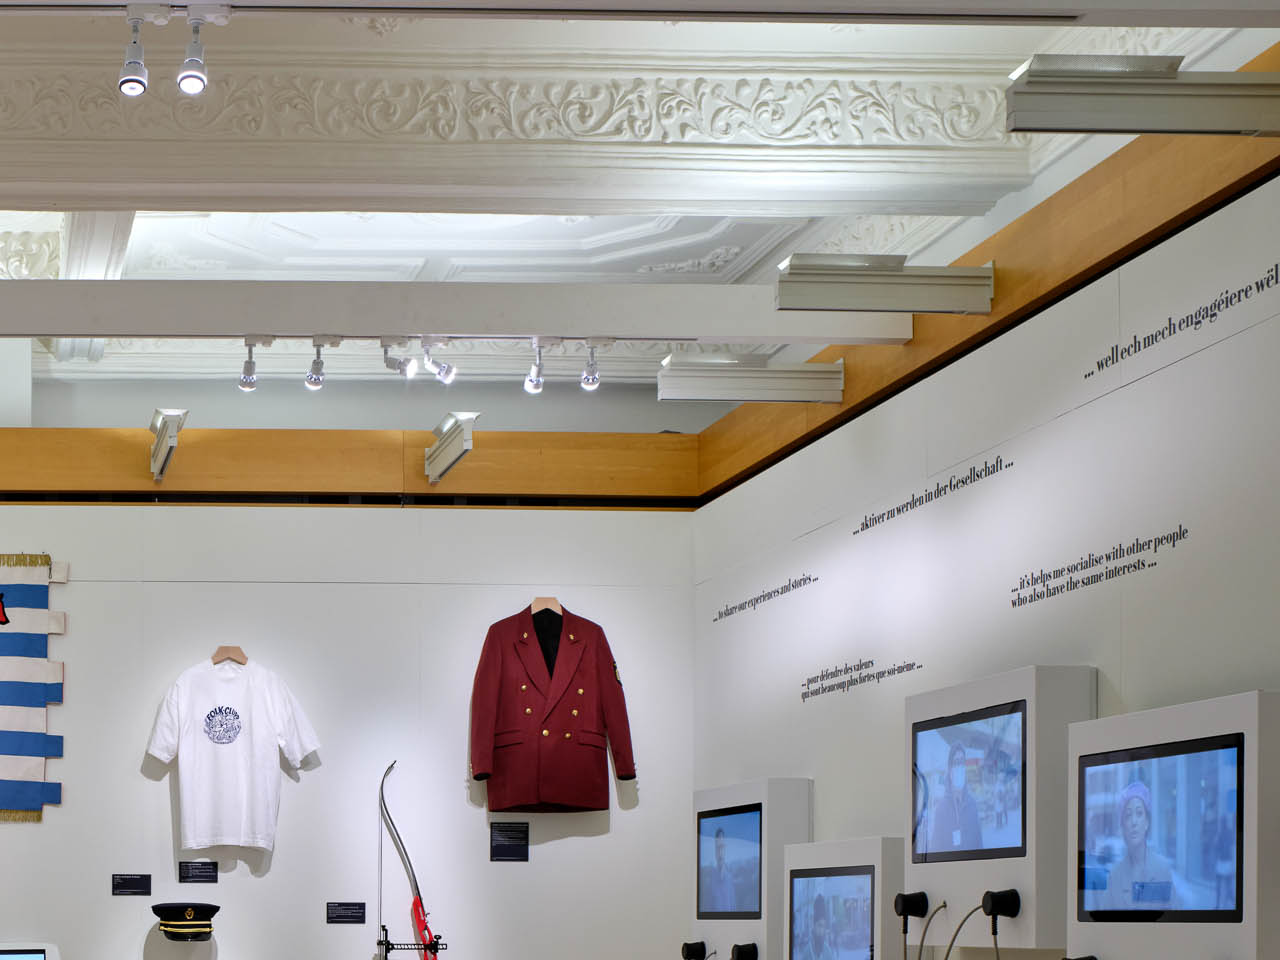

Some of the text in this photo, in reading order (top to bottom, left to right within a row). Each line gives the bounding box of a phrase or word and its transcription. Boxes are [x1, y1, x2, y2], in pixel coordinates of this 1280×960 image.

[1096, 344, 1119, 372] well
[1120, 335, 1141, 360] ech
[1142, 317, 1176, 350] mech
[1178, 284, 1252, 330] engagéiere
[860, 512, 886, 532] aktiver
[887, 508, 895, 520] zu
[896, 494, 924, 516] werden
[925, 490, 933, 503] in
[934, 482, 948, 499] der
[949, 455, 1003, 491] Gesellschaft
[1031, 569, 1052, 587] helps
[1052, 566, 1065, 579] me
[1066, 552, 1104, 575] socialise
[1104, 543, 1125, 564] with
[1126, 538, 1152, 558] other
[1154, 524, 1188, 553] people
[724, 604, 738, 617] share
[738, 601, 747, 612] our
[748, 588, 779, 610] experiences
[780, 578, 791, 595] and
[791, 573, 811, 590] stories
[1012, 593, 1028, 608] who
[1028, 589, 1045, 604] also
[1046, 583, 1065, 598] have
[1066, 576, 1080, 592] the
[1081, 571, 1104, 588] same
[1105, 559, 1146, 580] interests
[806, 675, 819, 690] pour
[843, 663, 853, 675] des
[853, 659, 874, 672] valeurs
[847, 675, 858, 692] plus
[859, 672, 875, 684] fortes
[876, 670, 886, 683] que
